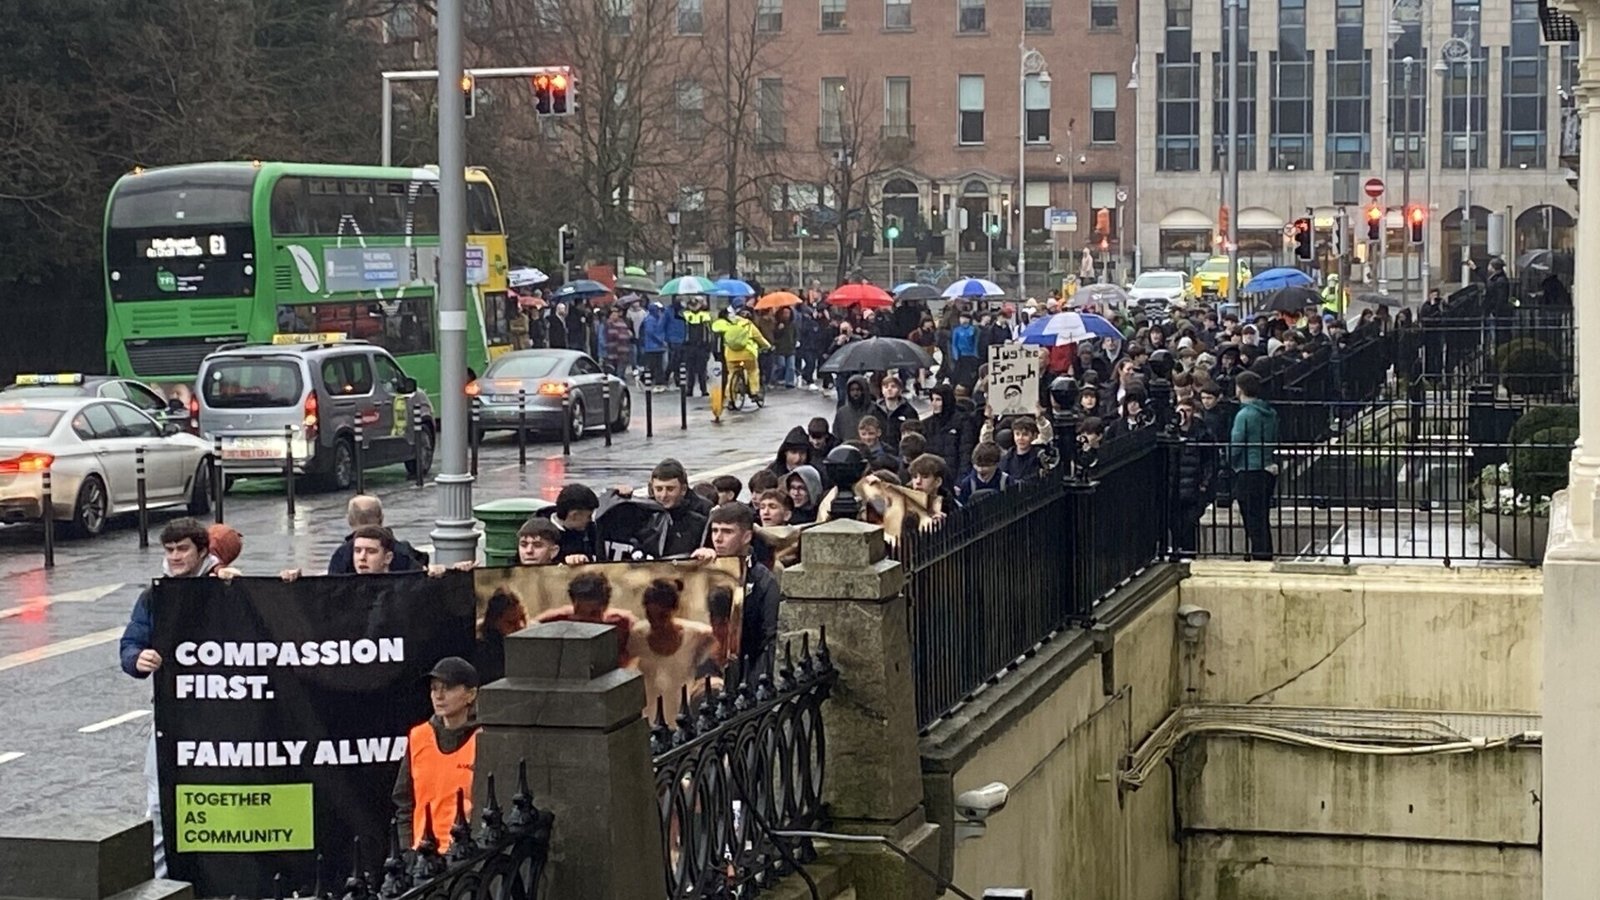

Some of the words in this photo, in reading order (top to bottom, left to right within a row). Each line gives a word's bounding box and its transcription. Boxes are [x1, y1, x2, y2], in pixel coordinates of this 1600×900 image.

[992, 361, 1014, 372] For
[176, 637, 404, 667] COMPASSION
[176, 674, 275, 700] FIRST.
[177, 740, 308, 767] FAMILY
[184, 792, 272, 807] TOGETHER
[184, 811, 207, 825] AS
[184, 828, 293, 844] COMMUNITY
